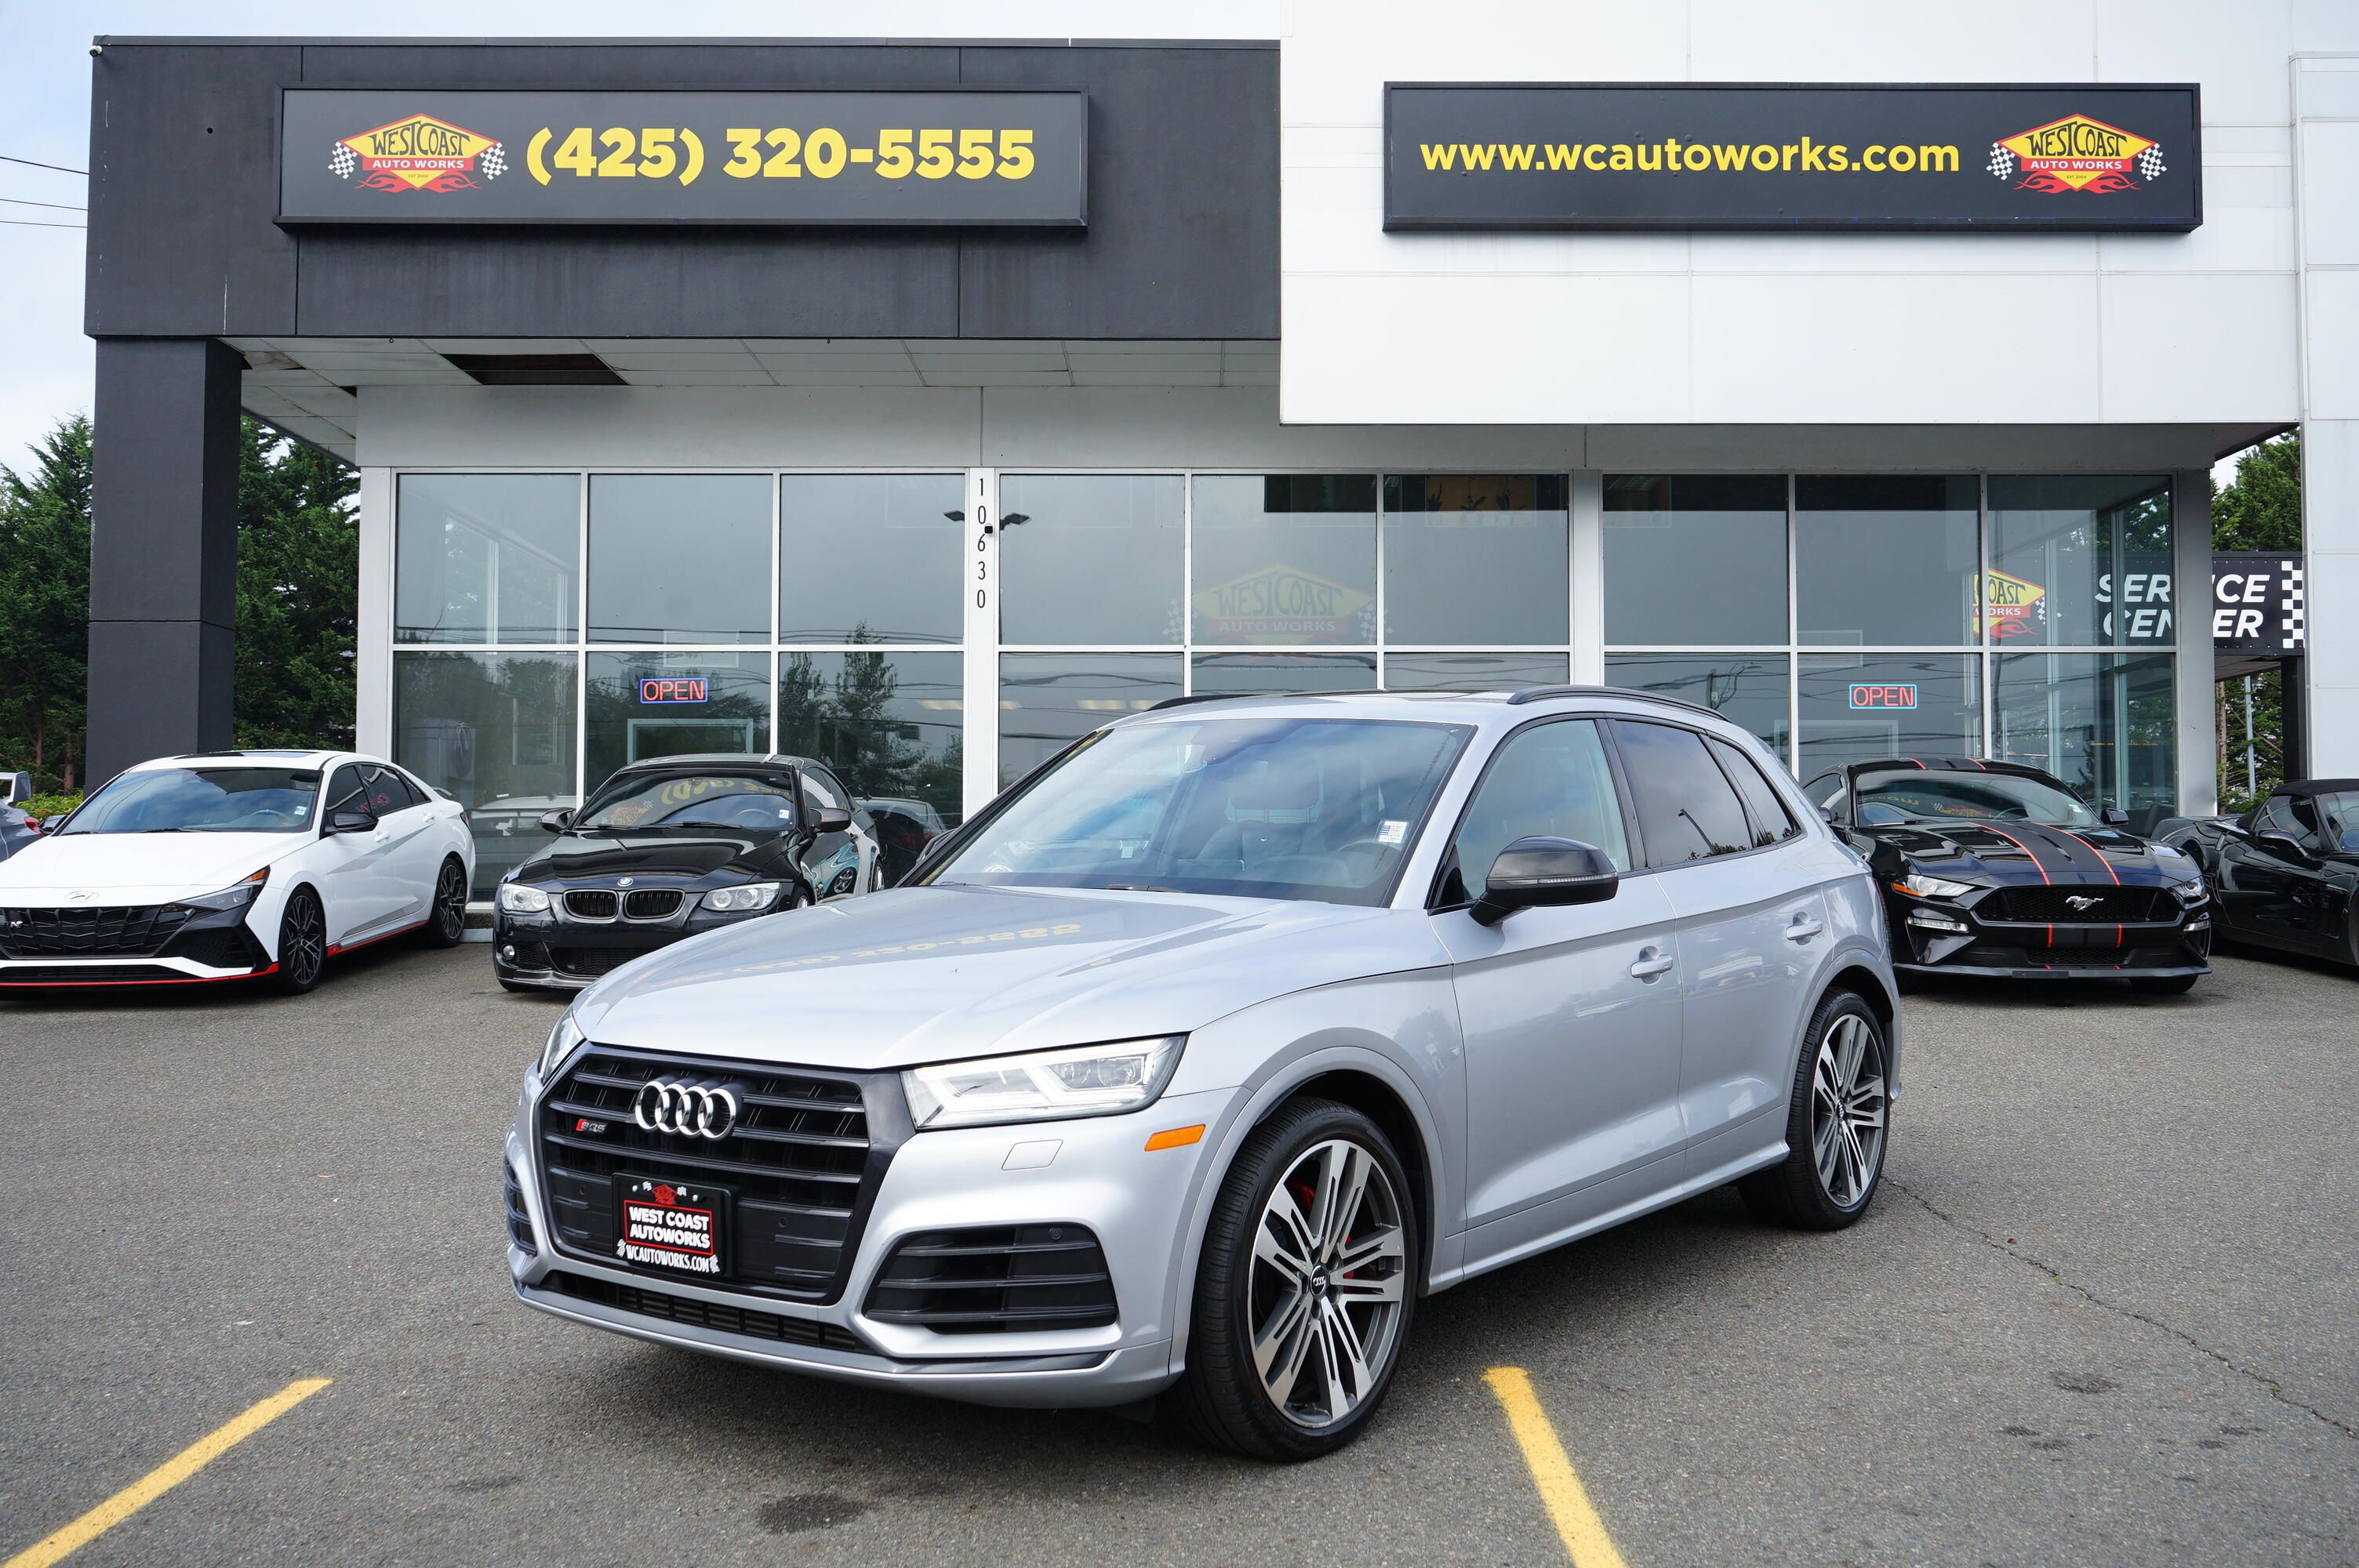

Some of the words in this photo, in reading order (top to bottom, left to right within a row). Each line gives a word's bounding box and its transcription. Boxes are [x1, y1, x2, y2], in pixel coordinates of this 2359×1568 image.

[373, 160, 411, 169] AUTO
[414, 160, 464, 169] WORKS
[526, 126, 704, 186] (425)
[723, 127, 1035, 180] 320-5555
[1419, 136, 1960, 172] www.wcautoworks.com
[2030, 161, 2069, 169] AUTO
[2072, 161, 2122, 169] WORKS
[977, 477, 987, 608] 10630
[1219, 620, 1267, 633] AUTO
[1272, 620, 1336, 633] WORKS
[643, 681, 704, 701] OPEN
[1853, 687, 1914, 706] OPEN
[629, 1206, 664, 1225] WEST
[666, 1211, 710, 1231] COAST
[630, 1223, 711, 1249] AUTOWORKS
[625, 1244, 710, 1273] WCAUTOWORKS.COM
